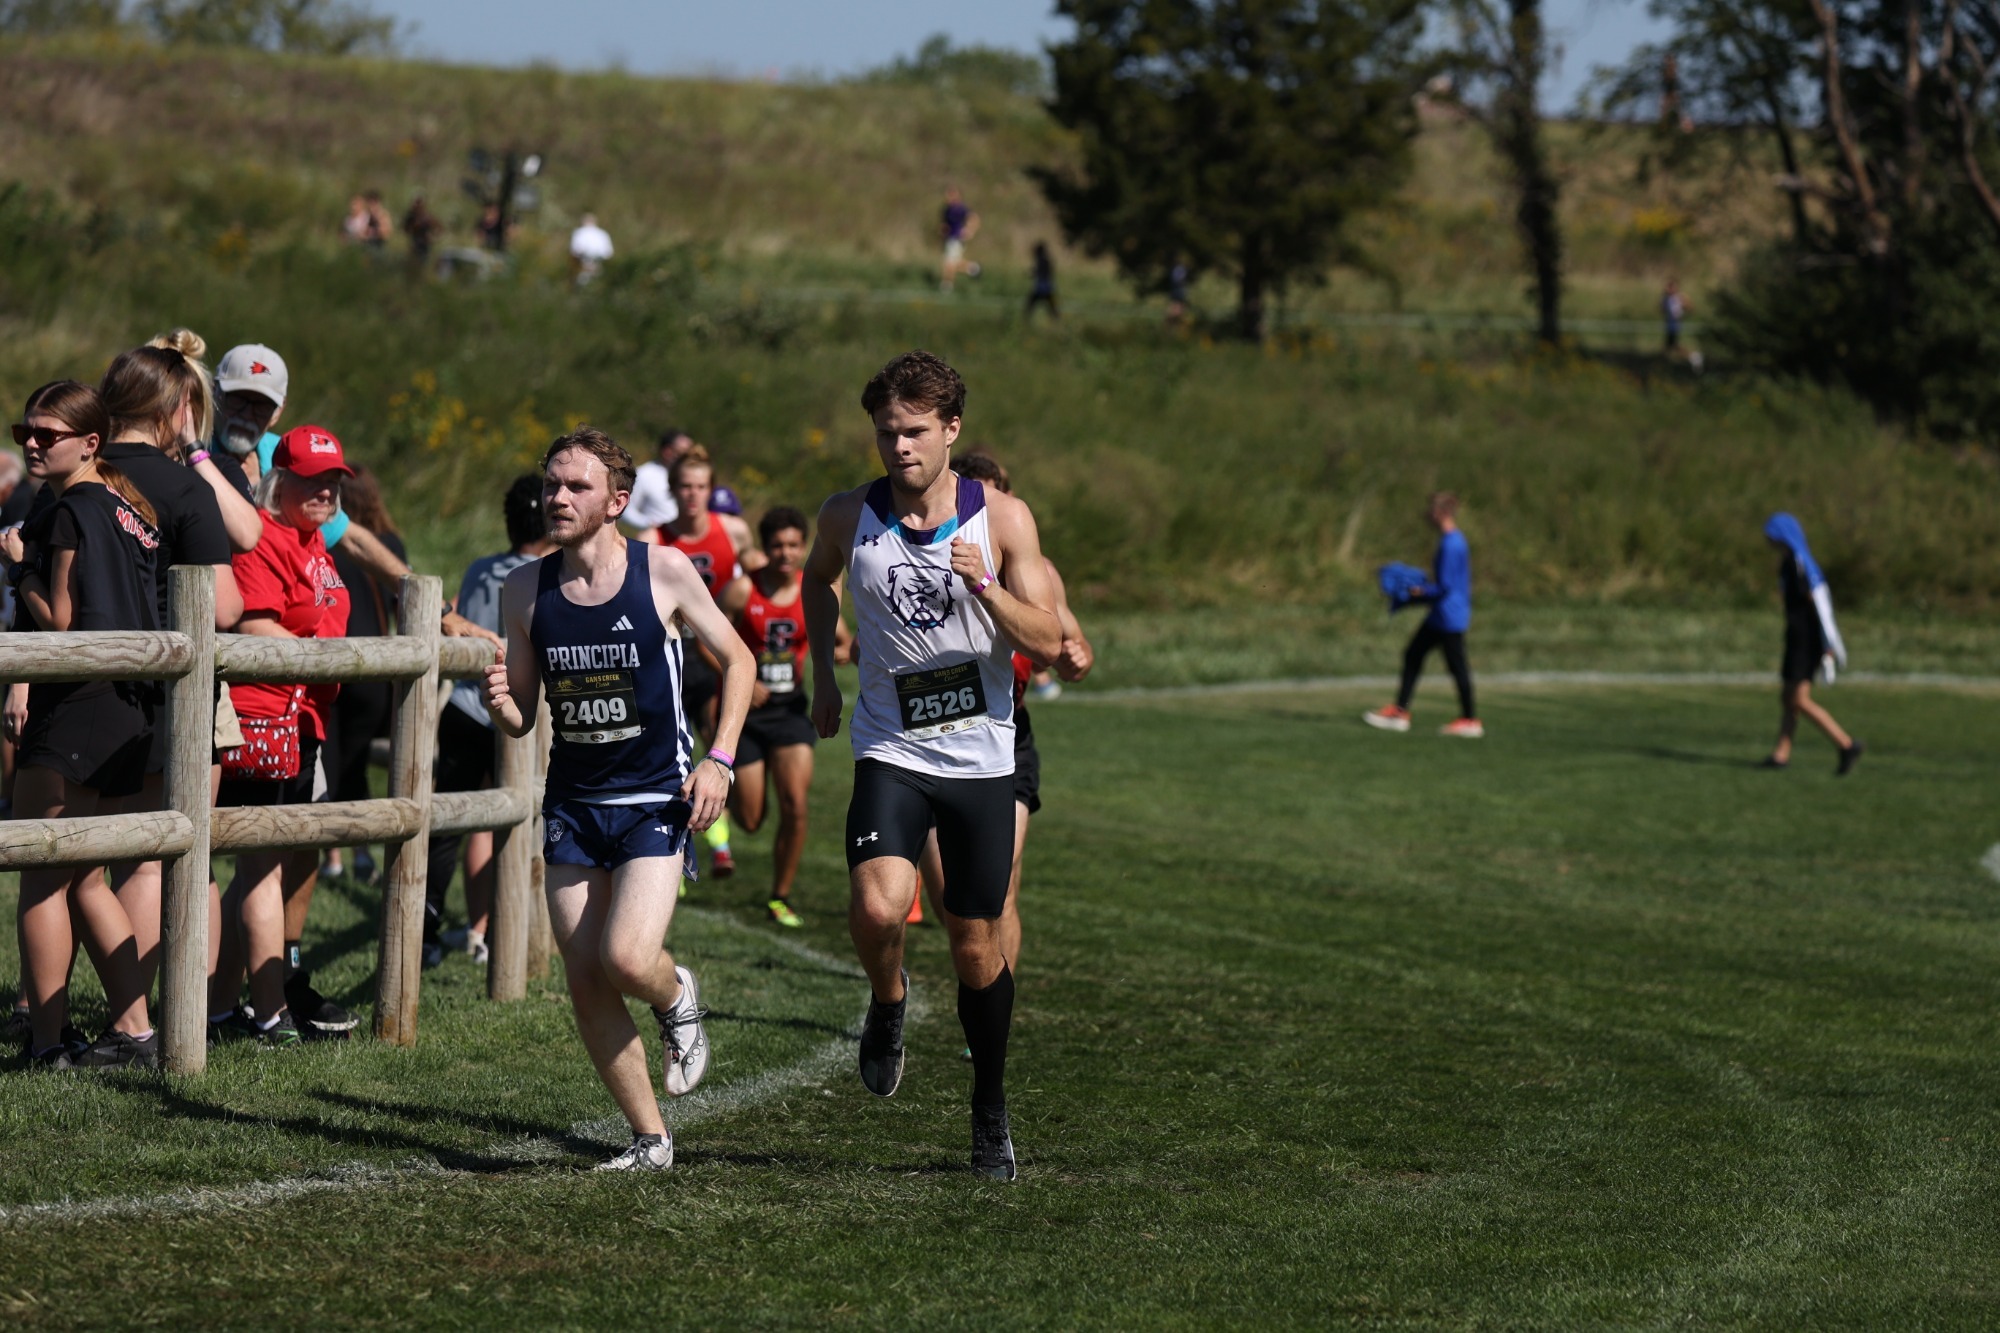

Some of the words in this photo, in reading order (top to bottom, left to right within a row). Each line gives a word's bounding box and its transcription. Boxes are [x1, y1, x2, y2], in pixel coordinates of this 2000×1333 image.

[546, 643, 640, 671] PRINCIPIA
[951, 665, 968, 674] CREEK
[585, 675, 601, 683] GANS
[602, 674, 620, 682] CREEK
[560, 697, 627, 725] 2409
[908, 686, 976, 722] 2526
